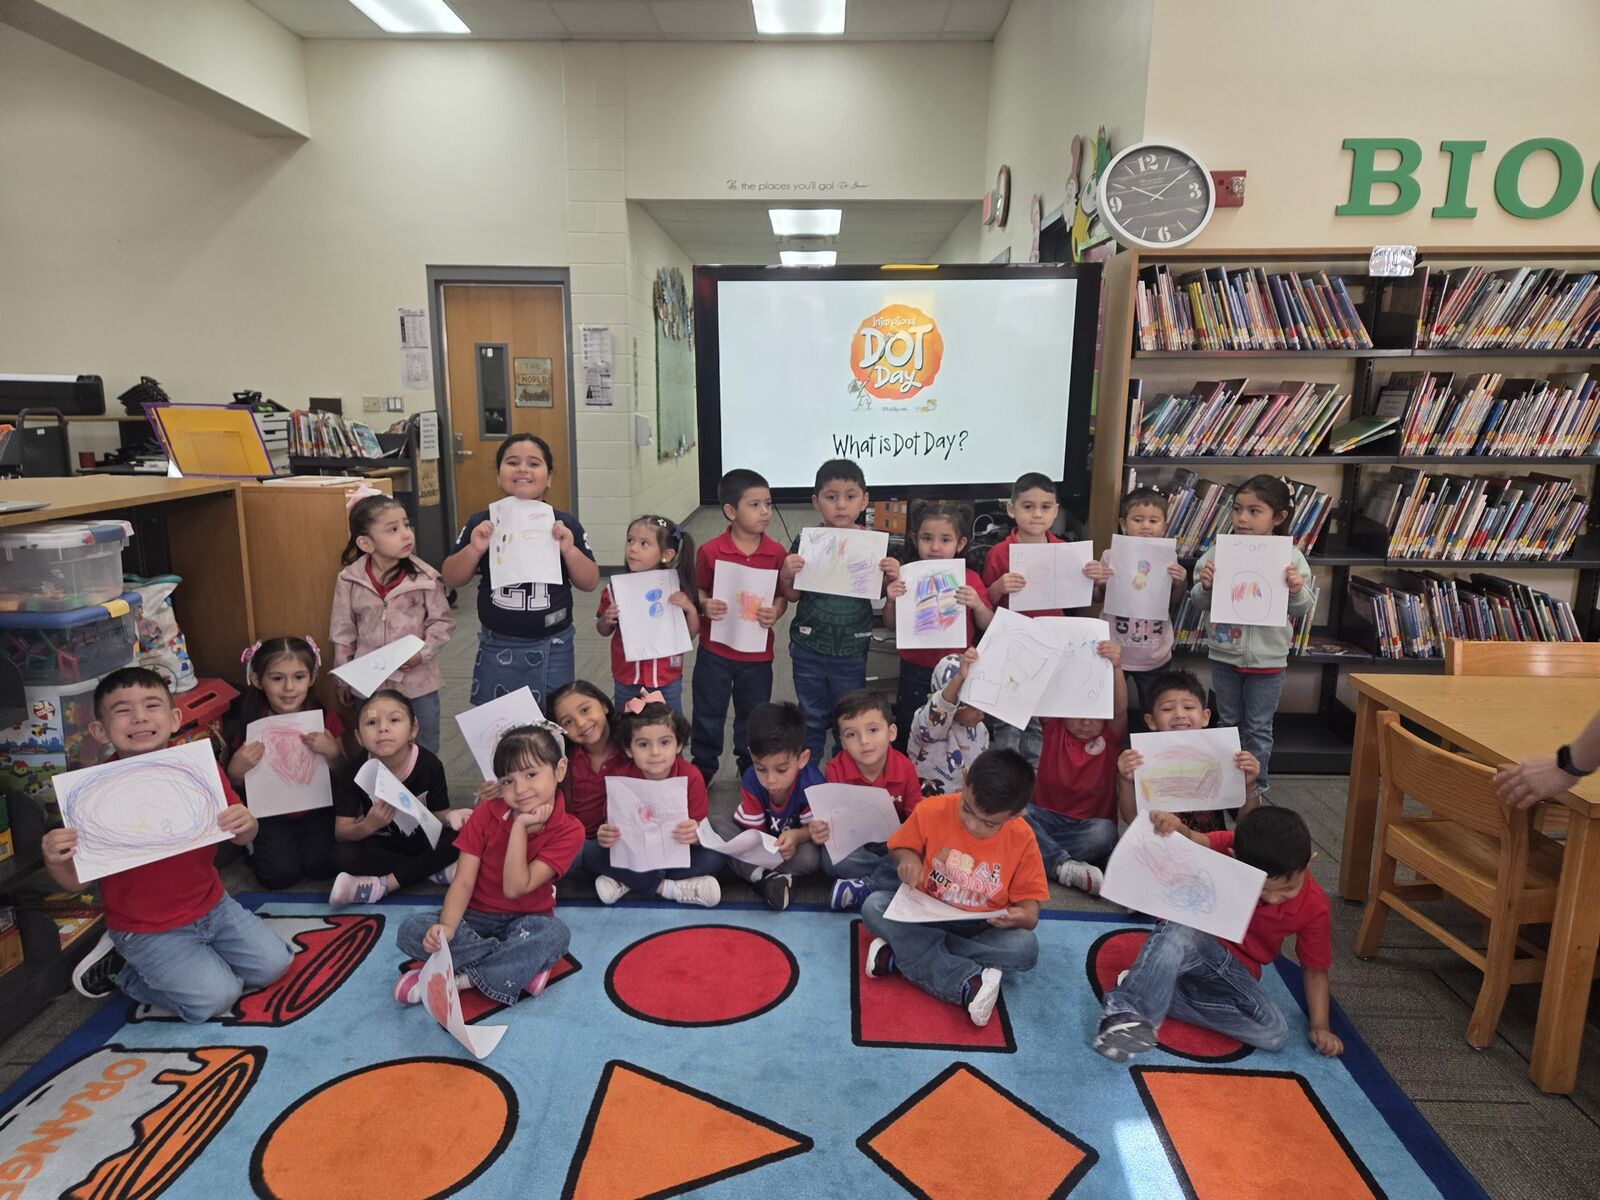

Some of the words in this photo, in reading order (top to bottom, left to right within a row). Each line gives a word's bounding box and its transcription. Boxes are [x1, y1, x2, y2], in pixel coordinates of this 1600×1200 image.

[1138, 154, 1159, 172] 12
[741, 181, 756, 190] the
[758, 181, 791, 192] places
[793, 181, 816, 192] you'll
[1335, 137, 1600, 220] BIO
[1189, 182, 1202, 199] 3
[1109, 196, 1122, 213] 9
[1158, 225, 1171, 242] 6
[872, 316, 918, 328] International
[859, 324, 934, 370] DOT
[874, 366, 922, 393] Day
[833, 432, 877, 459] What
[879, 435, 892, 455] is
[893, 431, 920, 457] Dot
[924, 430, 969, 460] Day?
[929, 869, 952, 888] NOT
